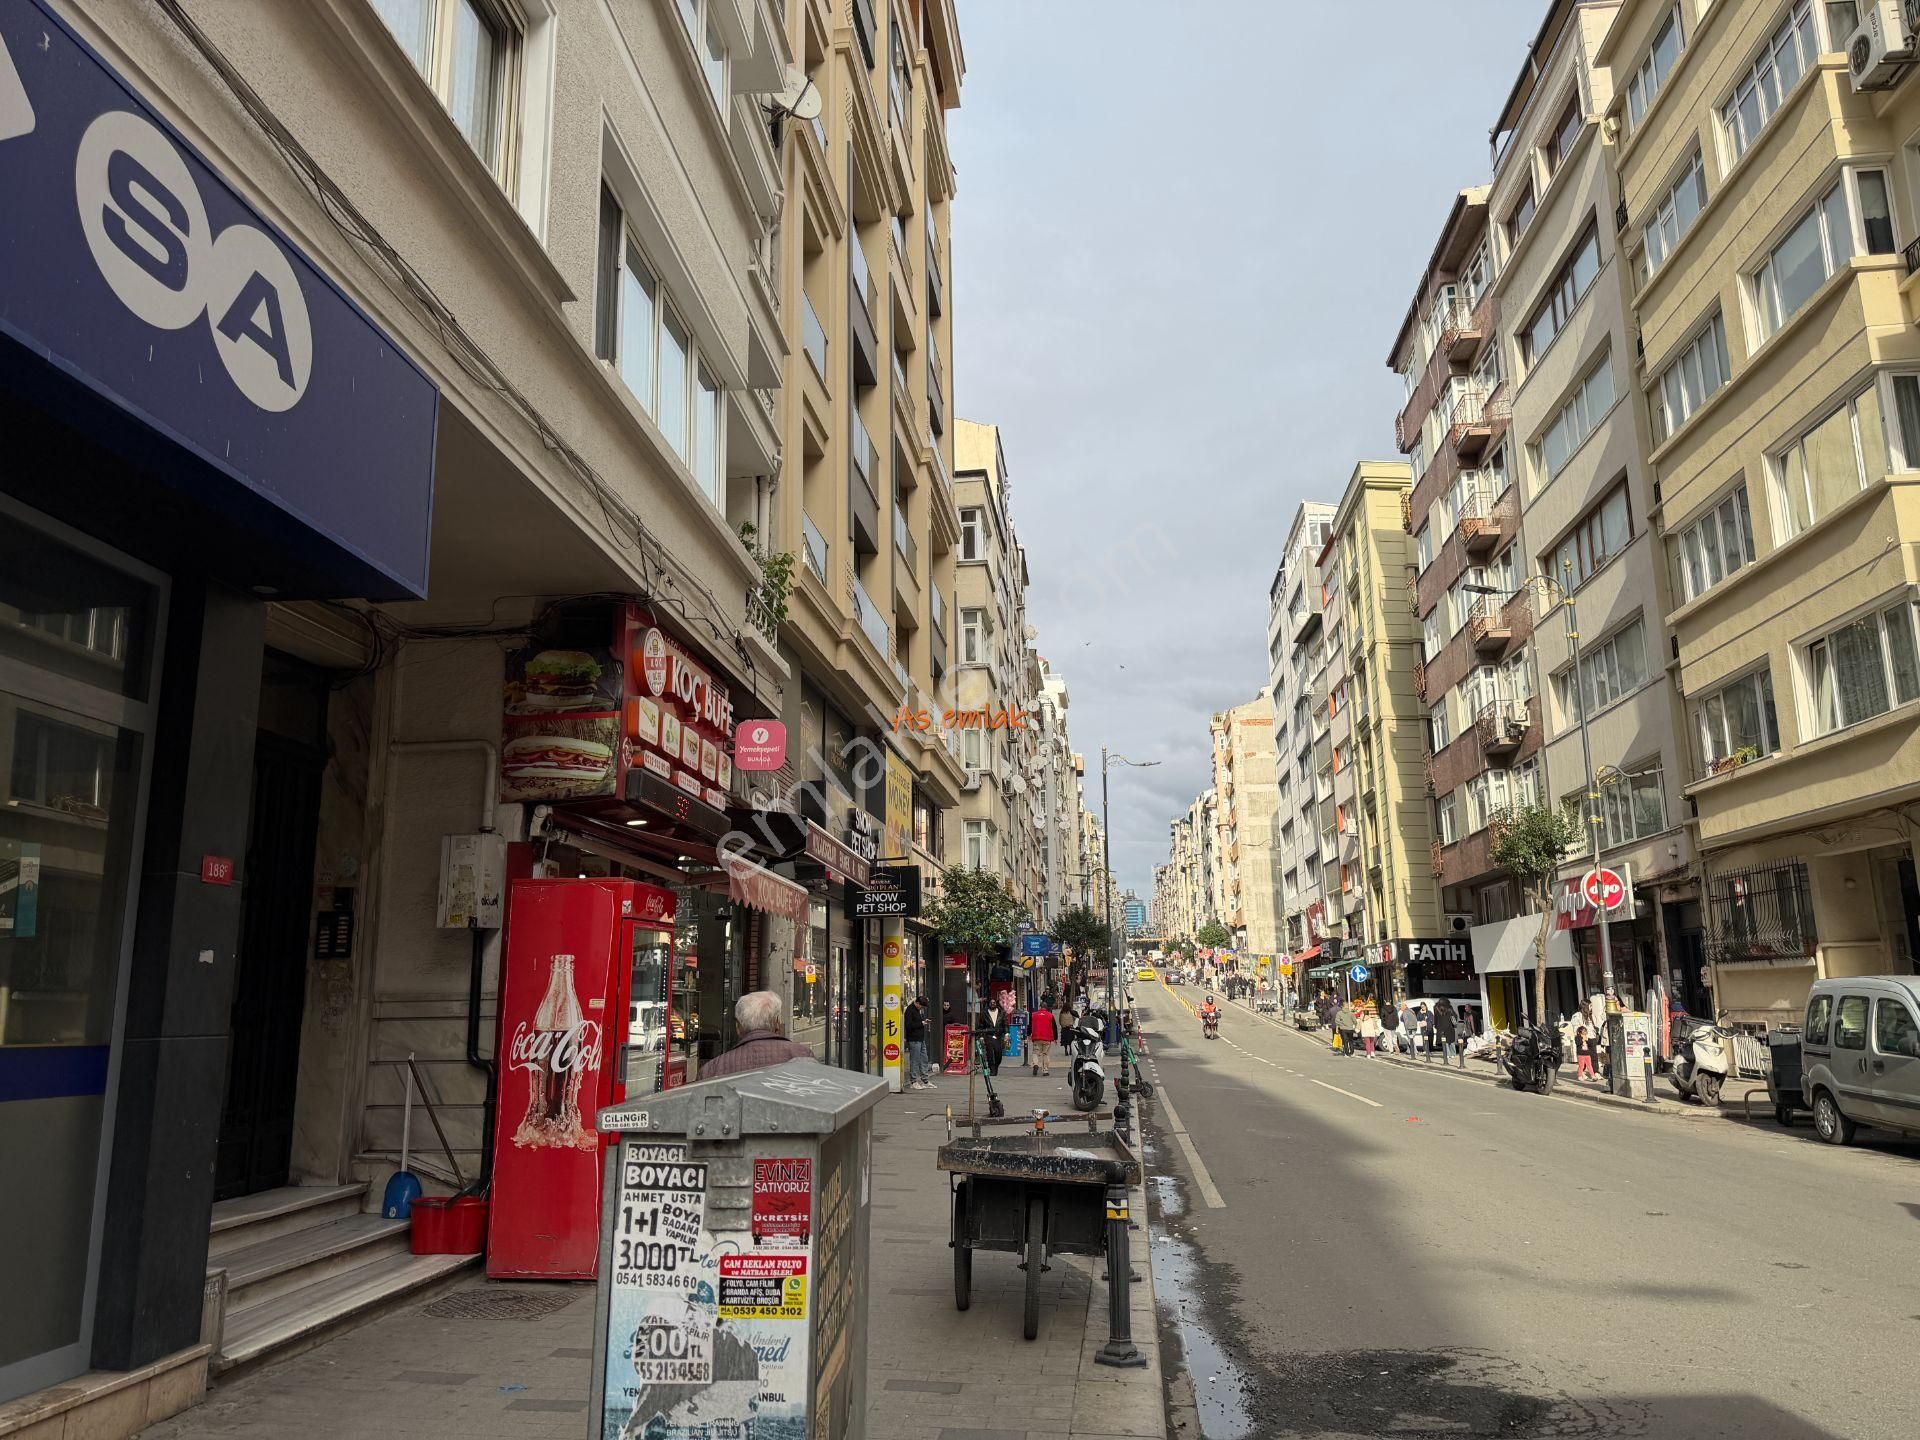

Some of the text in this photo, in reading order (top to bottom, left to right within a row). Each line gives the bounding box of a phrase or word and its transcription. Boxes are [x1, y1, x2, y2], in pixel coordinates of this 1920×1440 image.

[672, 656, 701, 722] KOÇ
[705, 682, 734, 738] BÜFE
[855, 808, 872, 836] SNOW
[852, 830, 861, 855] PET
[864, 893, 899, 903] SNOW
[1559, 884, 1586, 921] dyo
[856, 903, 907, 913] PET SHOP
[1408, 939, 1467, 961] FATİH
[628, 1147, 684, 1161] BOYACI
[626, 1165, 705, 1188] BOYACI
[754, 1159, 810, 1182] EVİNİZİ
[754, 1181, 810, 1193] SATIYORUZ
[624, 1192, 702, 1204] AHMET USTA
[622, 1206, 659, 1237] 1+1
[661, 1203, 701, 1226] BOYA
[753, 1212, 809, 1222] ÜCRETSİZ
[661, 1216, 699, 1237] BADANA
[665, 1228, 697, 1247] YAPILIR
[724, 1259, 802, 1269] CAM REKLAM FOLYO
[745, 1279, 759, 1287] CAM
[759, 1278, 775, 1287] FİLMİ
[726, 1288, 749, 1296] BRANDA
[733, 1307, 757, 1315] 0539
[759, 1307, 778, 1315] 450
[780, 1307, 802, 1315] 3102
[690, 1344, 703, 1358] TL
